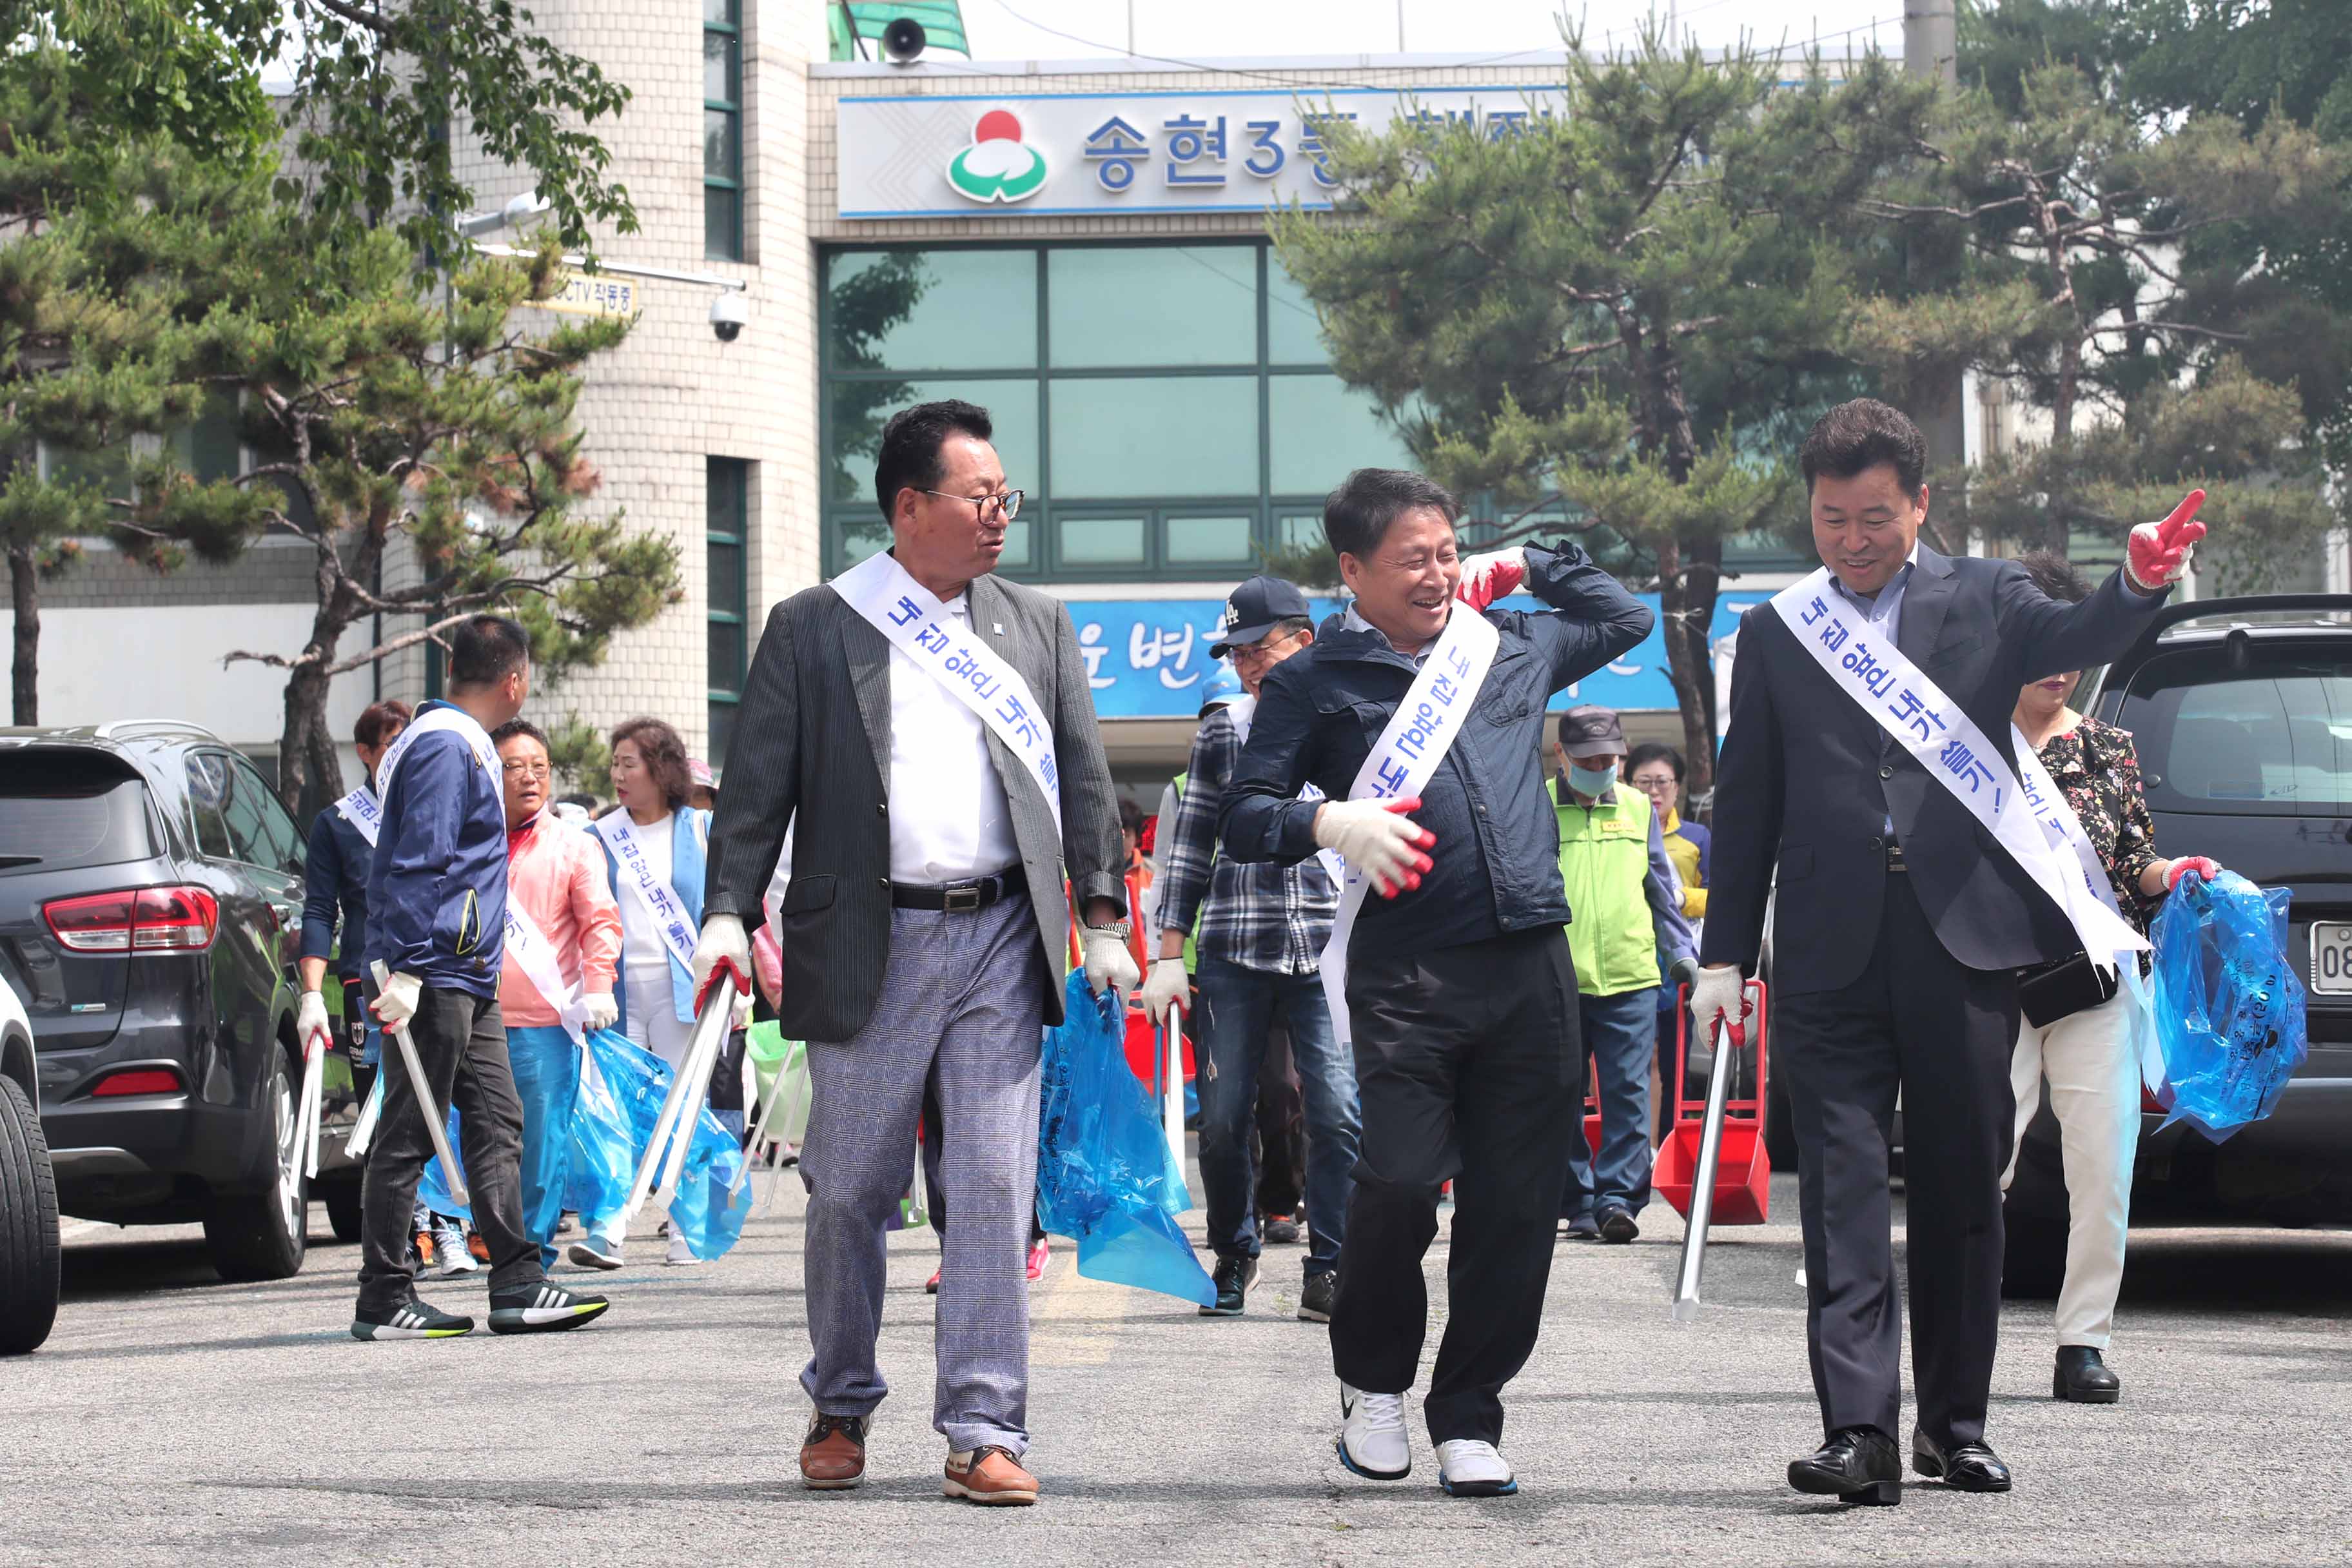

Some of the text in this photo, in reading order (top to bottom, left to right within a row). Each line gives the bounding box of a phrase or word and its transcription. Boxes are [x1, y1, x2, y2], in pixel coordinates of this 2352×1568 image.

[887, 596, 923, 627] 내
[915, 623, 950, 654] 집
[945, 649, 1001, 700] 앞은
[995, 694, 1043, 748] 내가
[1447, 645, 1471, 679] 내
[1800, 596, 1828, 626] 내
[1819, 619, 1849, 653] 집
[1841, 642, 1897, 699] 앞은
[1888, 688, 1947, 742] 내가
[1430, 673, 1458, 707] 집
[1395, 702, 1444, 760] 앞은
[613, 827, 630, 842] 내
[621, 843, 640, 859] 집
[631, 859, 656, 888] 앞은
[648, 887, 674, 917] 내가
